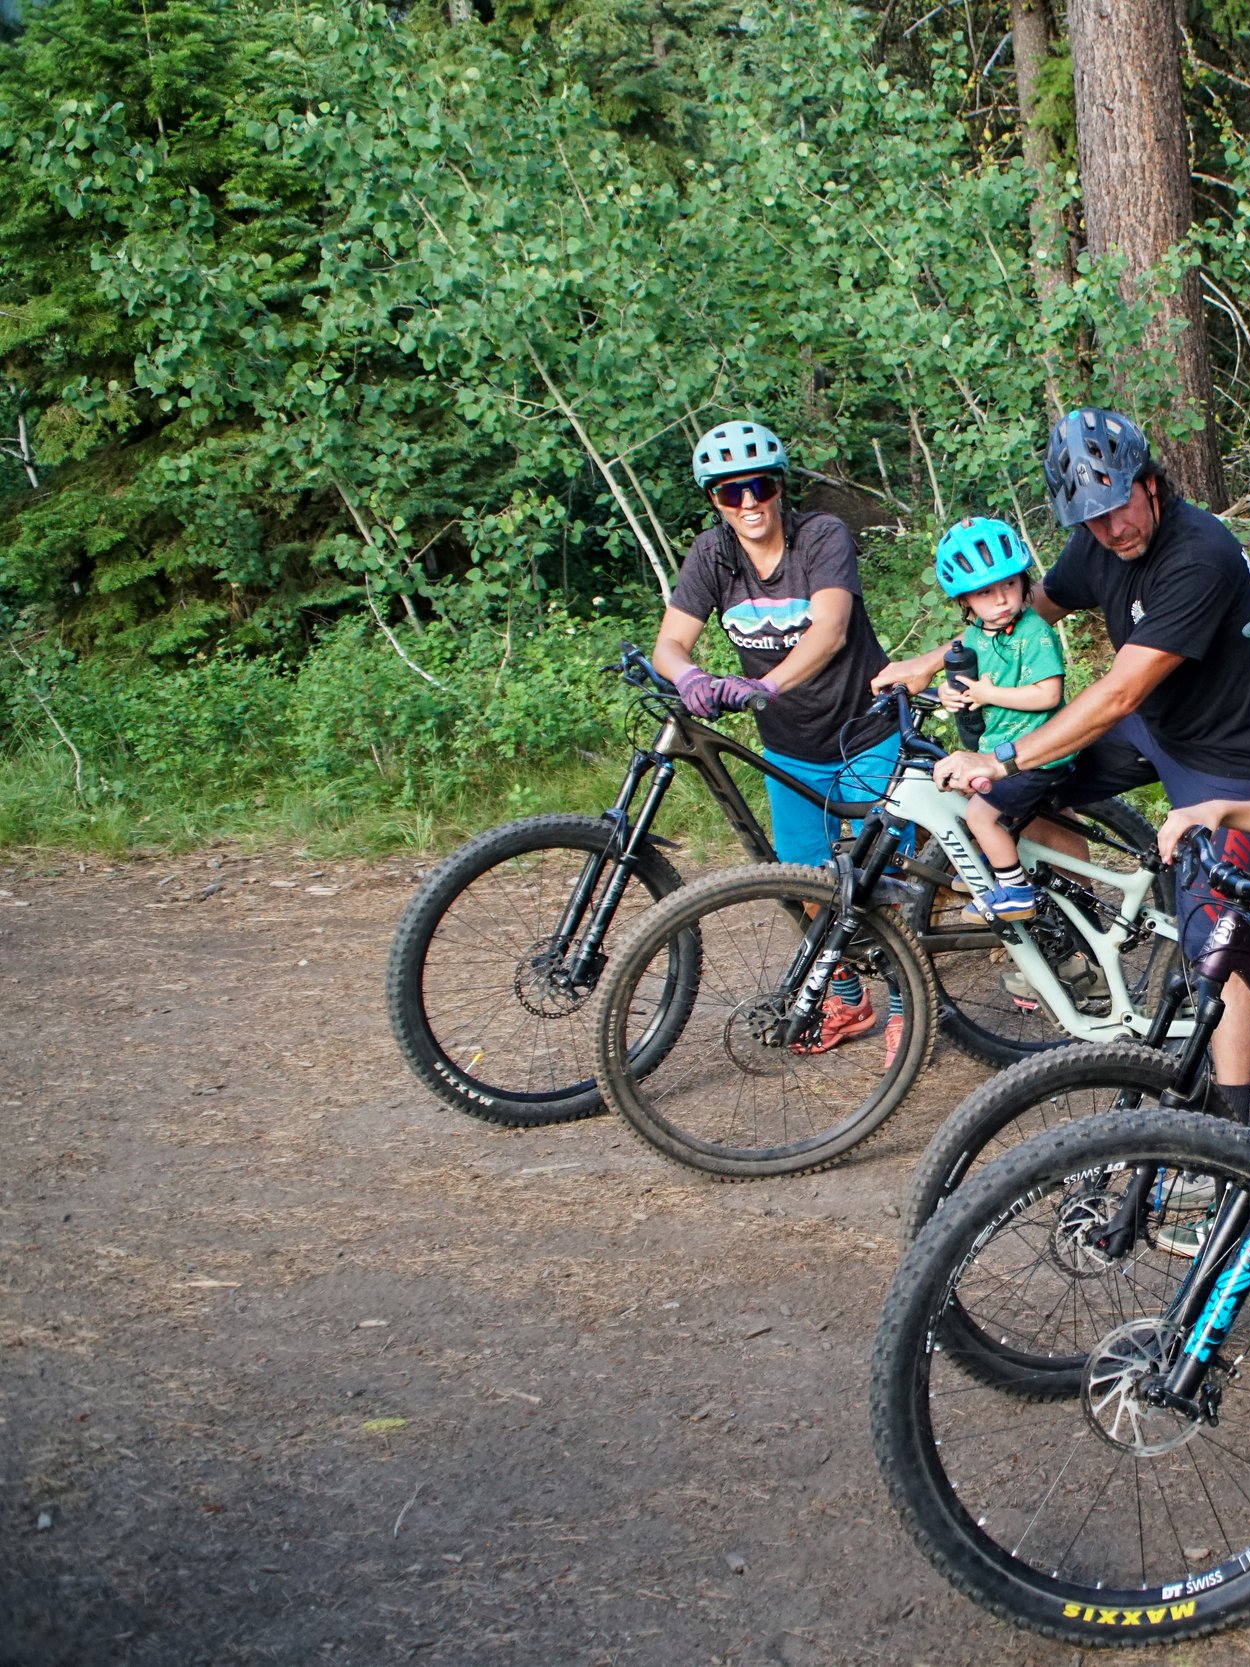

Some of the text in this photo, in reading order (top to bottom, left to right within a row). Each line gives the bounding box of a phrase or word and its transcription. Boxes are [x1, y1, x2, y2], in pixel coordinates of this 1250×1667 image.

[782, 632, 805, 648] id
[936, 829, 990, 897] SPECIA
[608, 1009, 617, 1058] BUTCHER
[433, 1061, 495, 1107] MAXXIS
[1063, 1161, 1126, 1185] DT SWISS
[1161, 1570, 1223, 1600] DT SWISS
[1062, 1601, 1197, 1626] MAXXIS
